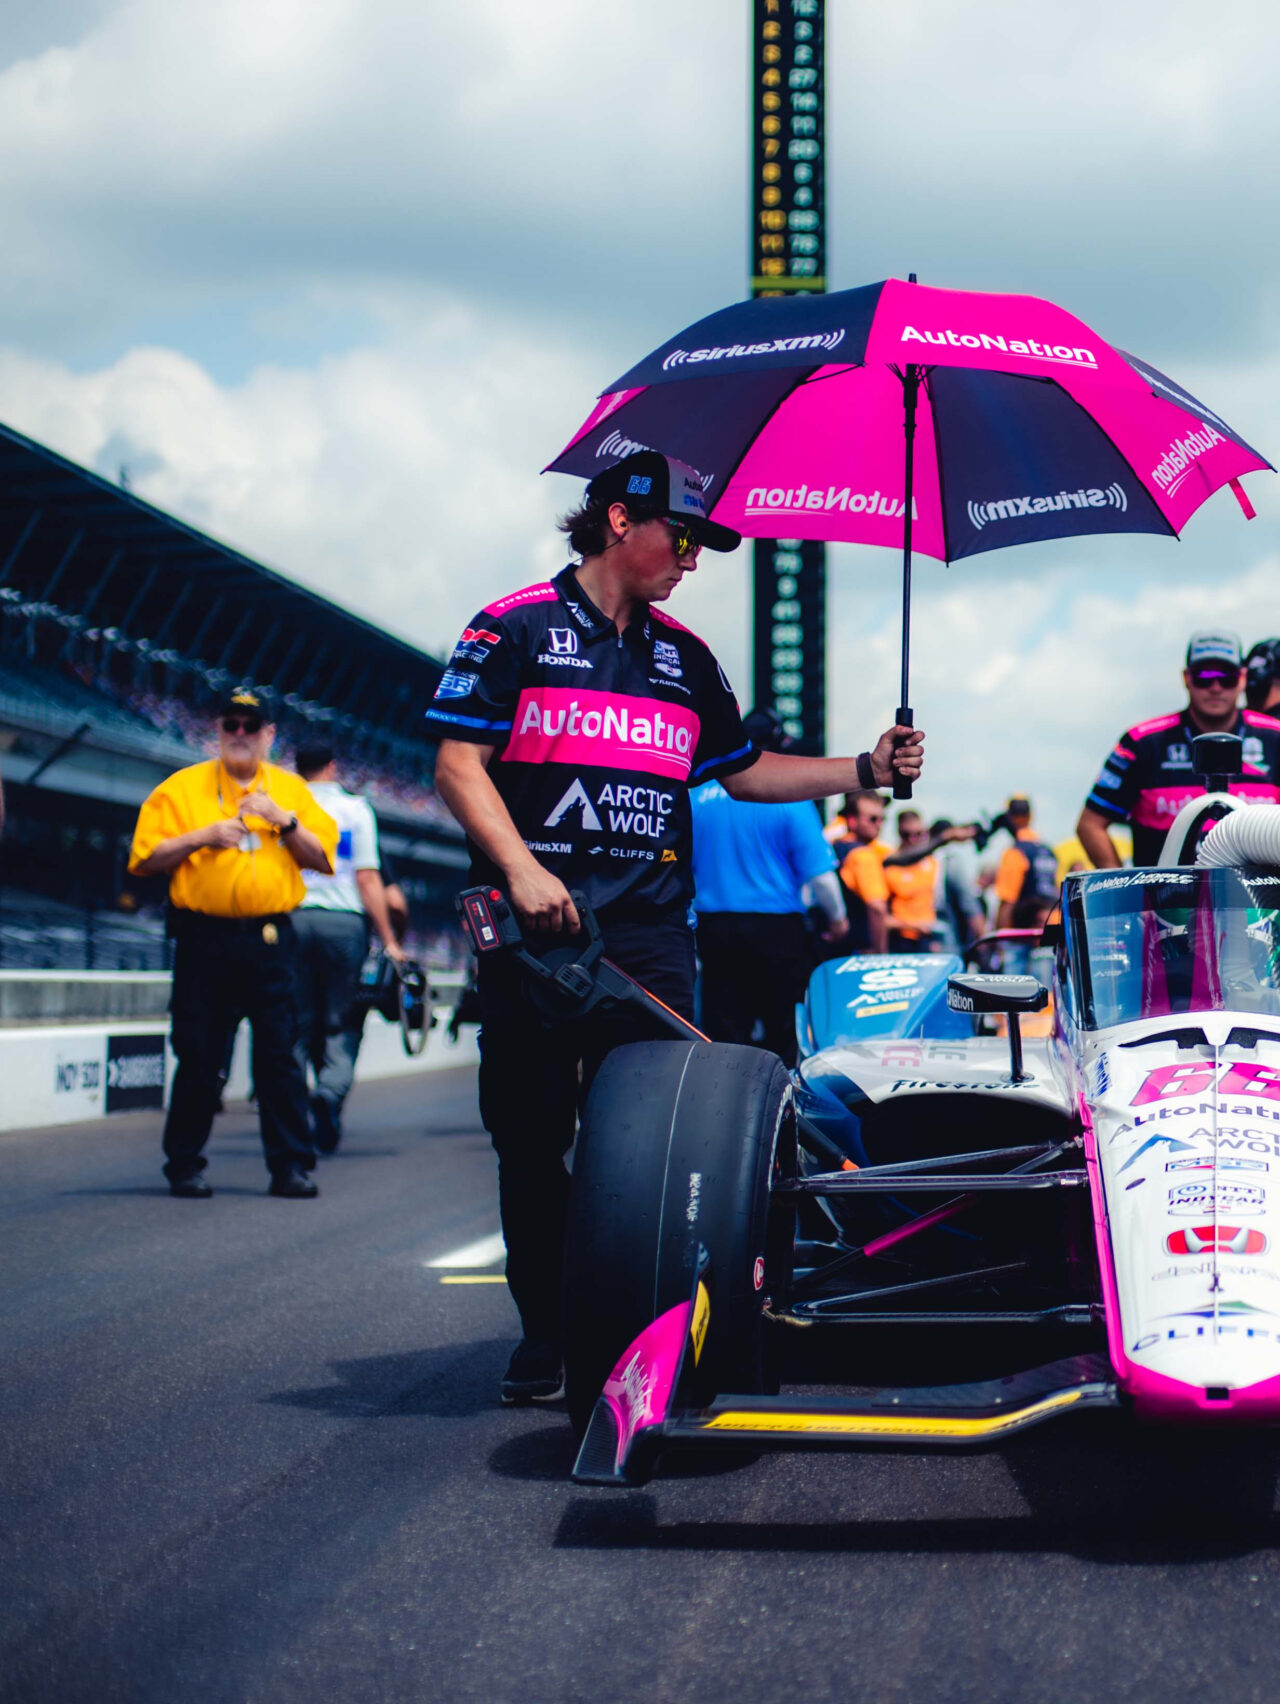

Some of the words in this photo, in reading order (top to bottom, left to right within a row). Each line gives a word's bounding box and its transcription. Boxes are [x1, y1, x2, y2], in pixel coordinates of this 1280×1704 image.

[900, 325, 1098, 363] AutoNation
[626, 475, 653, 495] 66
[537, 654, 595, 669] HONDA
[597, 783, 674, 815] ARCTIC
[618, 810, 666, 839] WOLF
[609, 847, 655, 861] CLIFFS
[1168, 1194, 1265, 1206] INDYCAR
